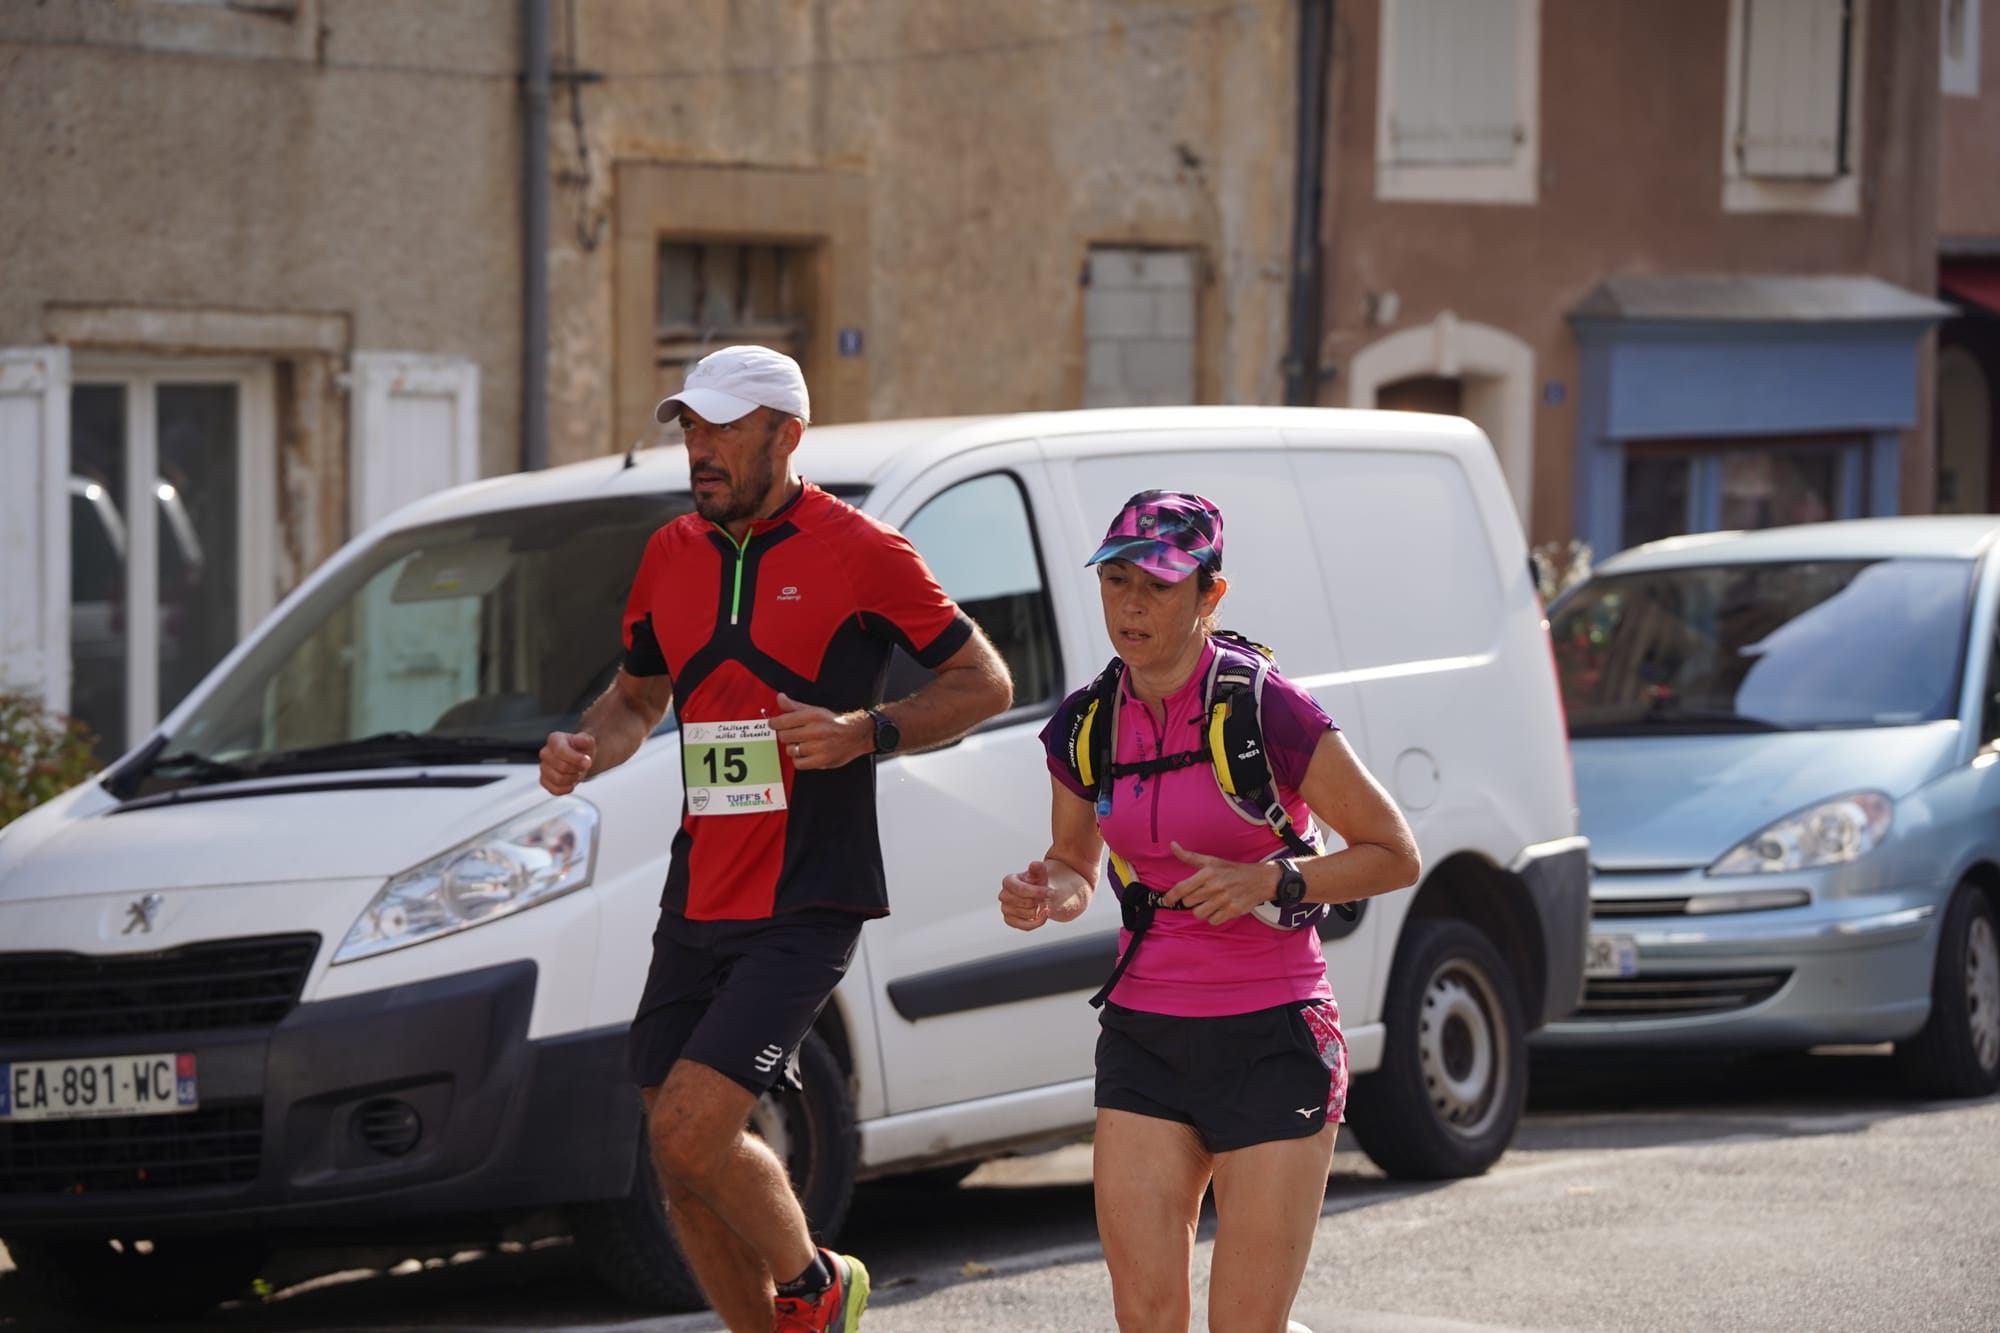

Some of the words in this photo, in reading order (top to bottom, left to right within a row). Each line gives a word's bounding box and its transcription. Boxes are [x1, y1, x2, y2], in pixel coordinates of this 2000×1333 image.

[704, 747, 747, 783] 15
[726, 793, 761, 802] TUFF'S
[14, 1061, 171, 1109] EA-891-WC
